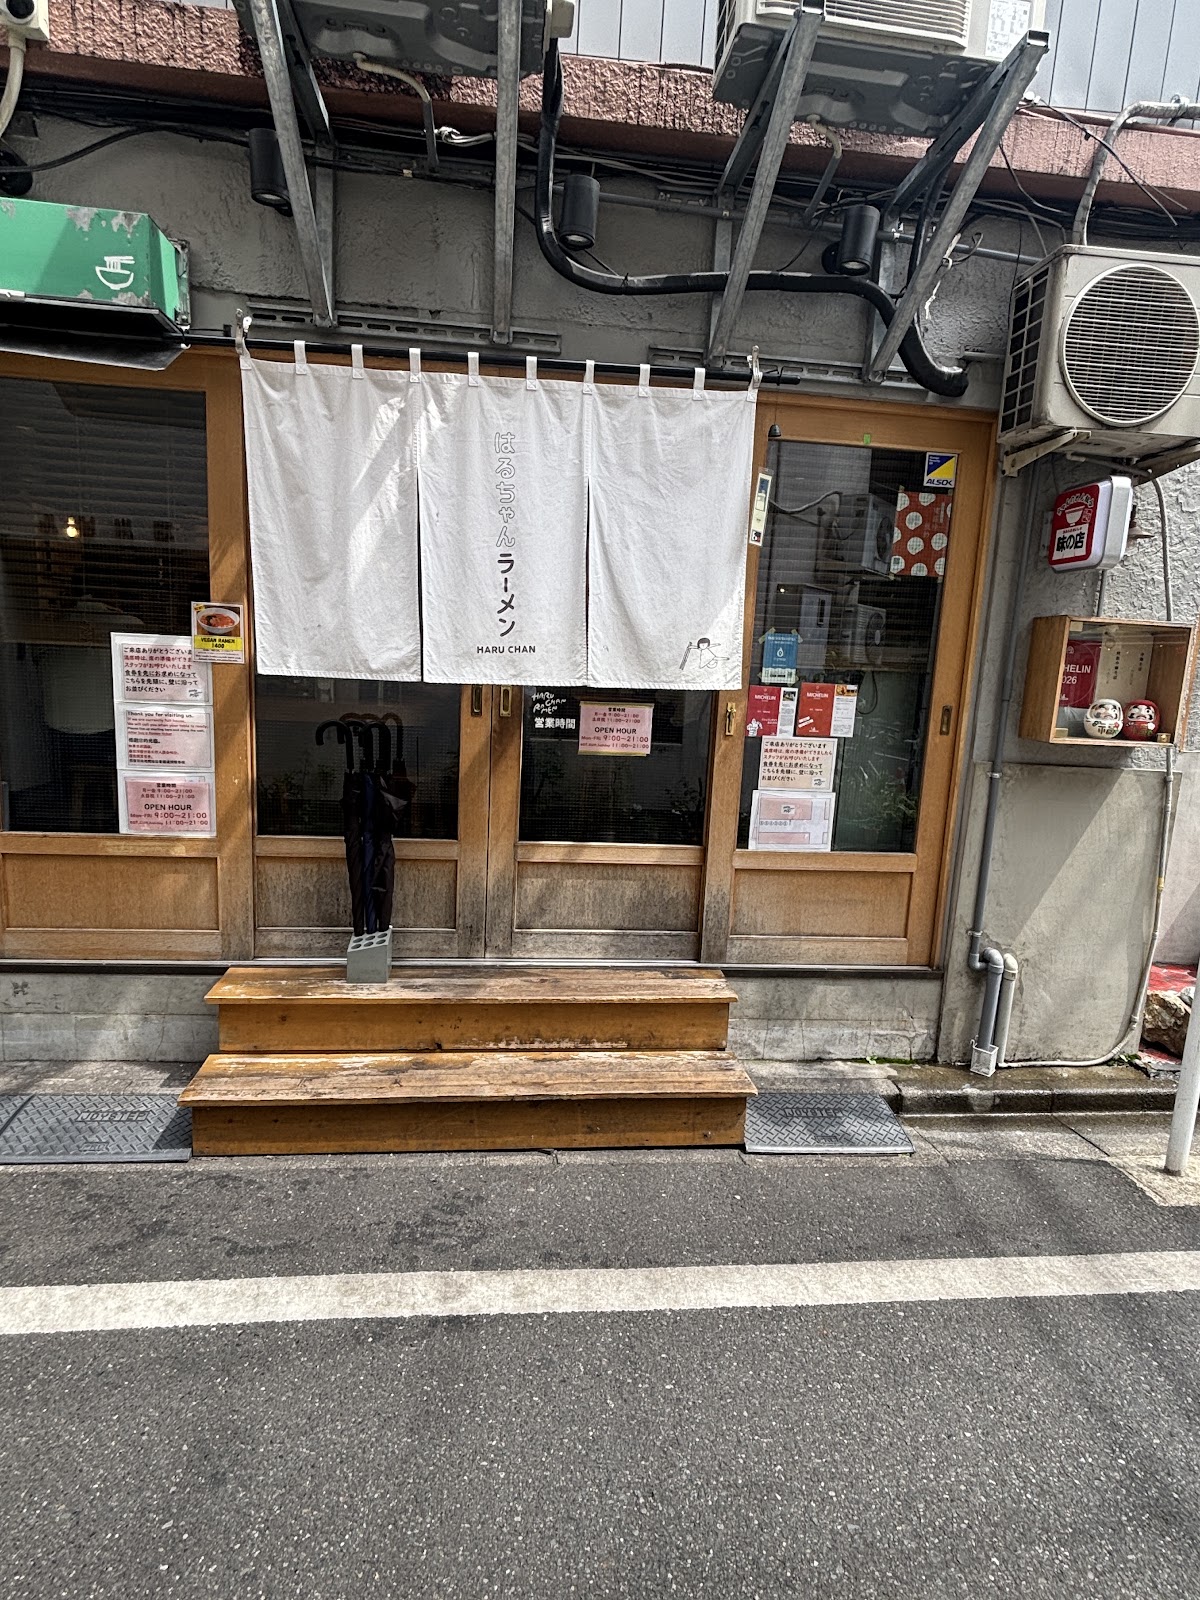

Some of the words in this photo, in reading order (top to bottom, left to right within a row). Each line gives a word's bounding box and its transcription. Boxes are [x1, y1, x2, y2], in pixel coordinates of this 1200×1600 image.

[926, 478, 953, 486] ALSOK
[494, 431, 516, 637] はるちゃんラーメン
[1056, 531, 1085, 552] 味の店
[476, 646, 505, 654] HARU
[507, 646, 536, 654] CHAN
[531, 692, 555, 701] HARU
[545, 699, 567, 707] CHAN
[534, 717, 576, 729] 営業時間
